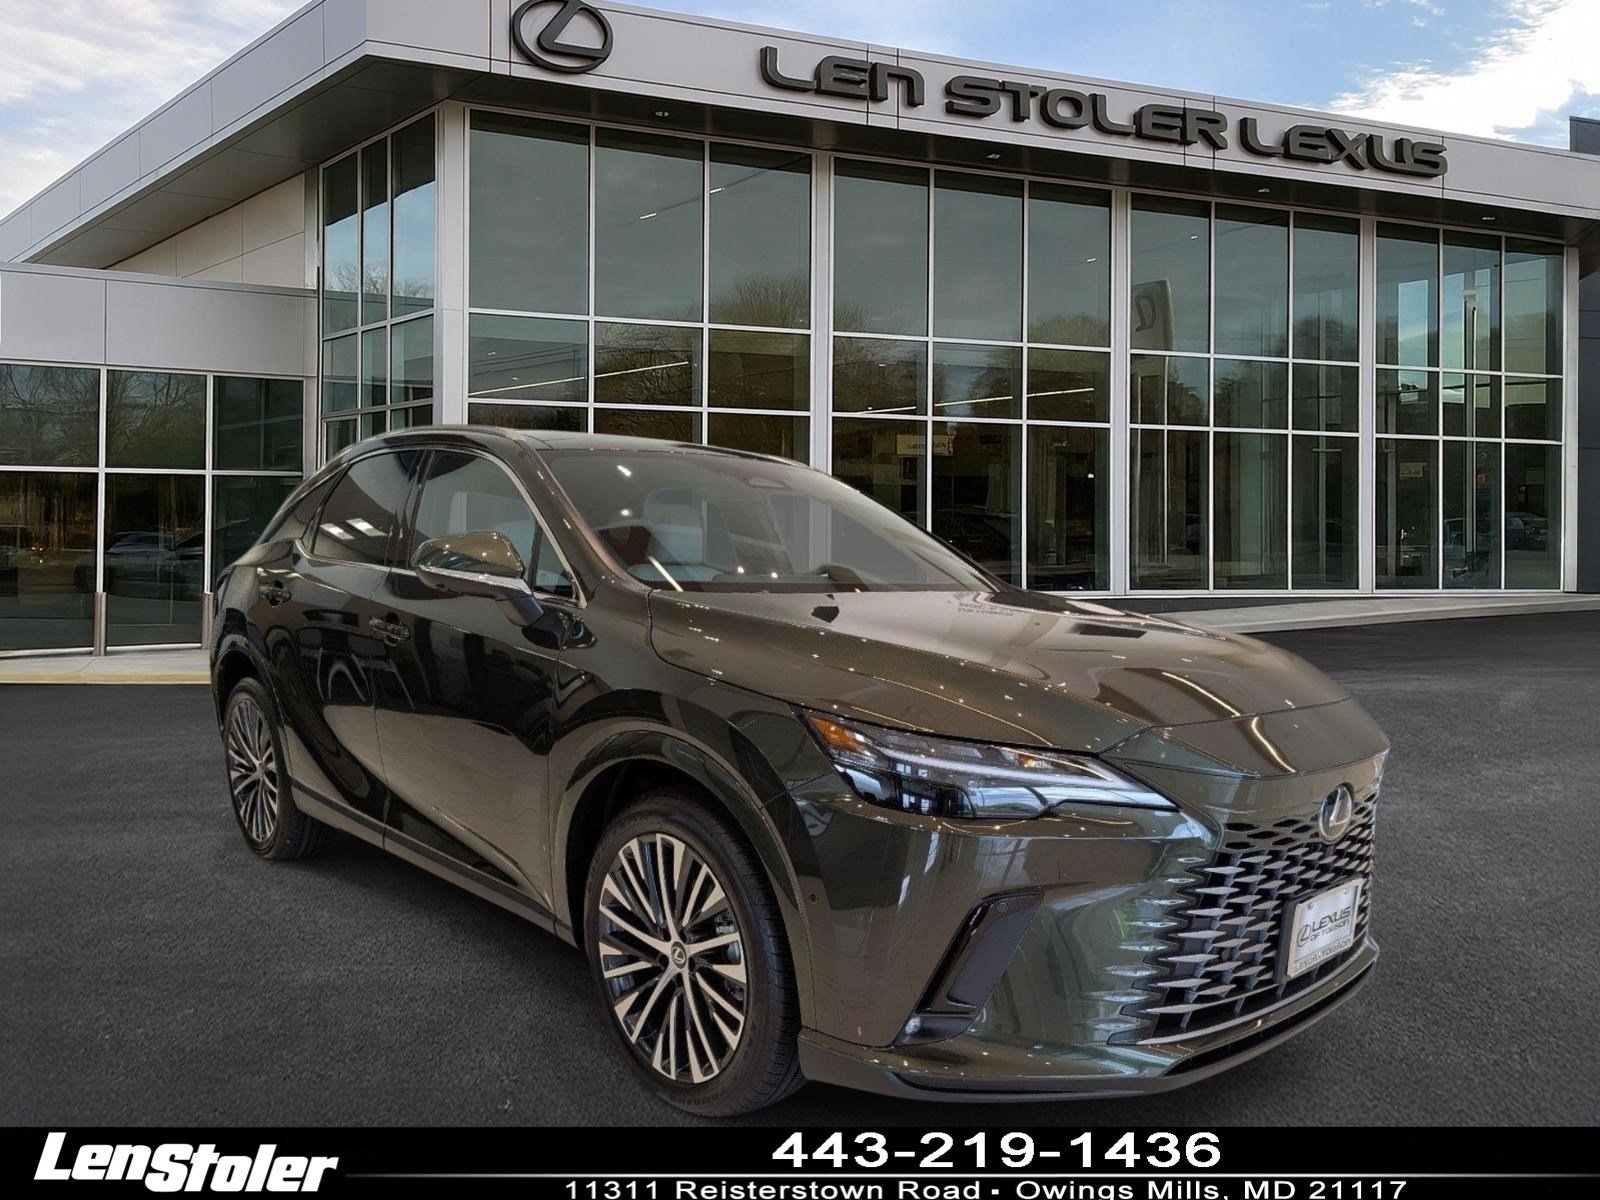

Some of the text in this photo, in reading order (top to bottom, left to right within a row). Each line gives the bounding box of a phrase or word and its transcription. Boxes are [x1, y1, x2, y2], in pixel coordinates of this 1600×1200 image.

[760, 46, 1448, 178] LEN STOLER LEXUS
[1312, 906, 1351, 931] LEXUS
